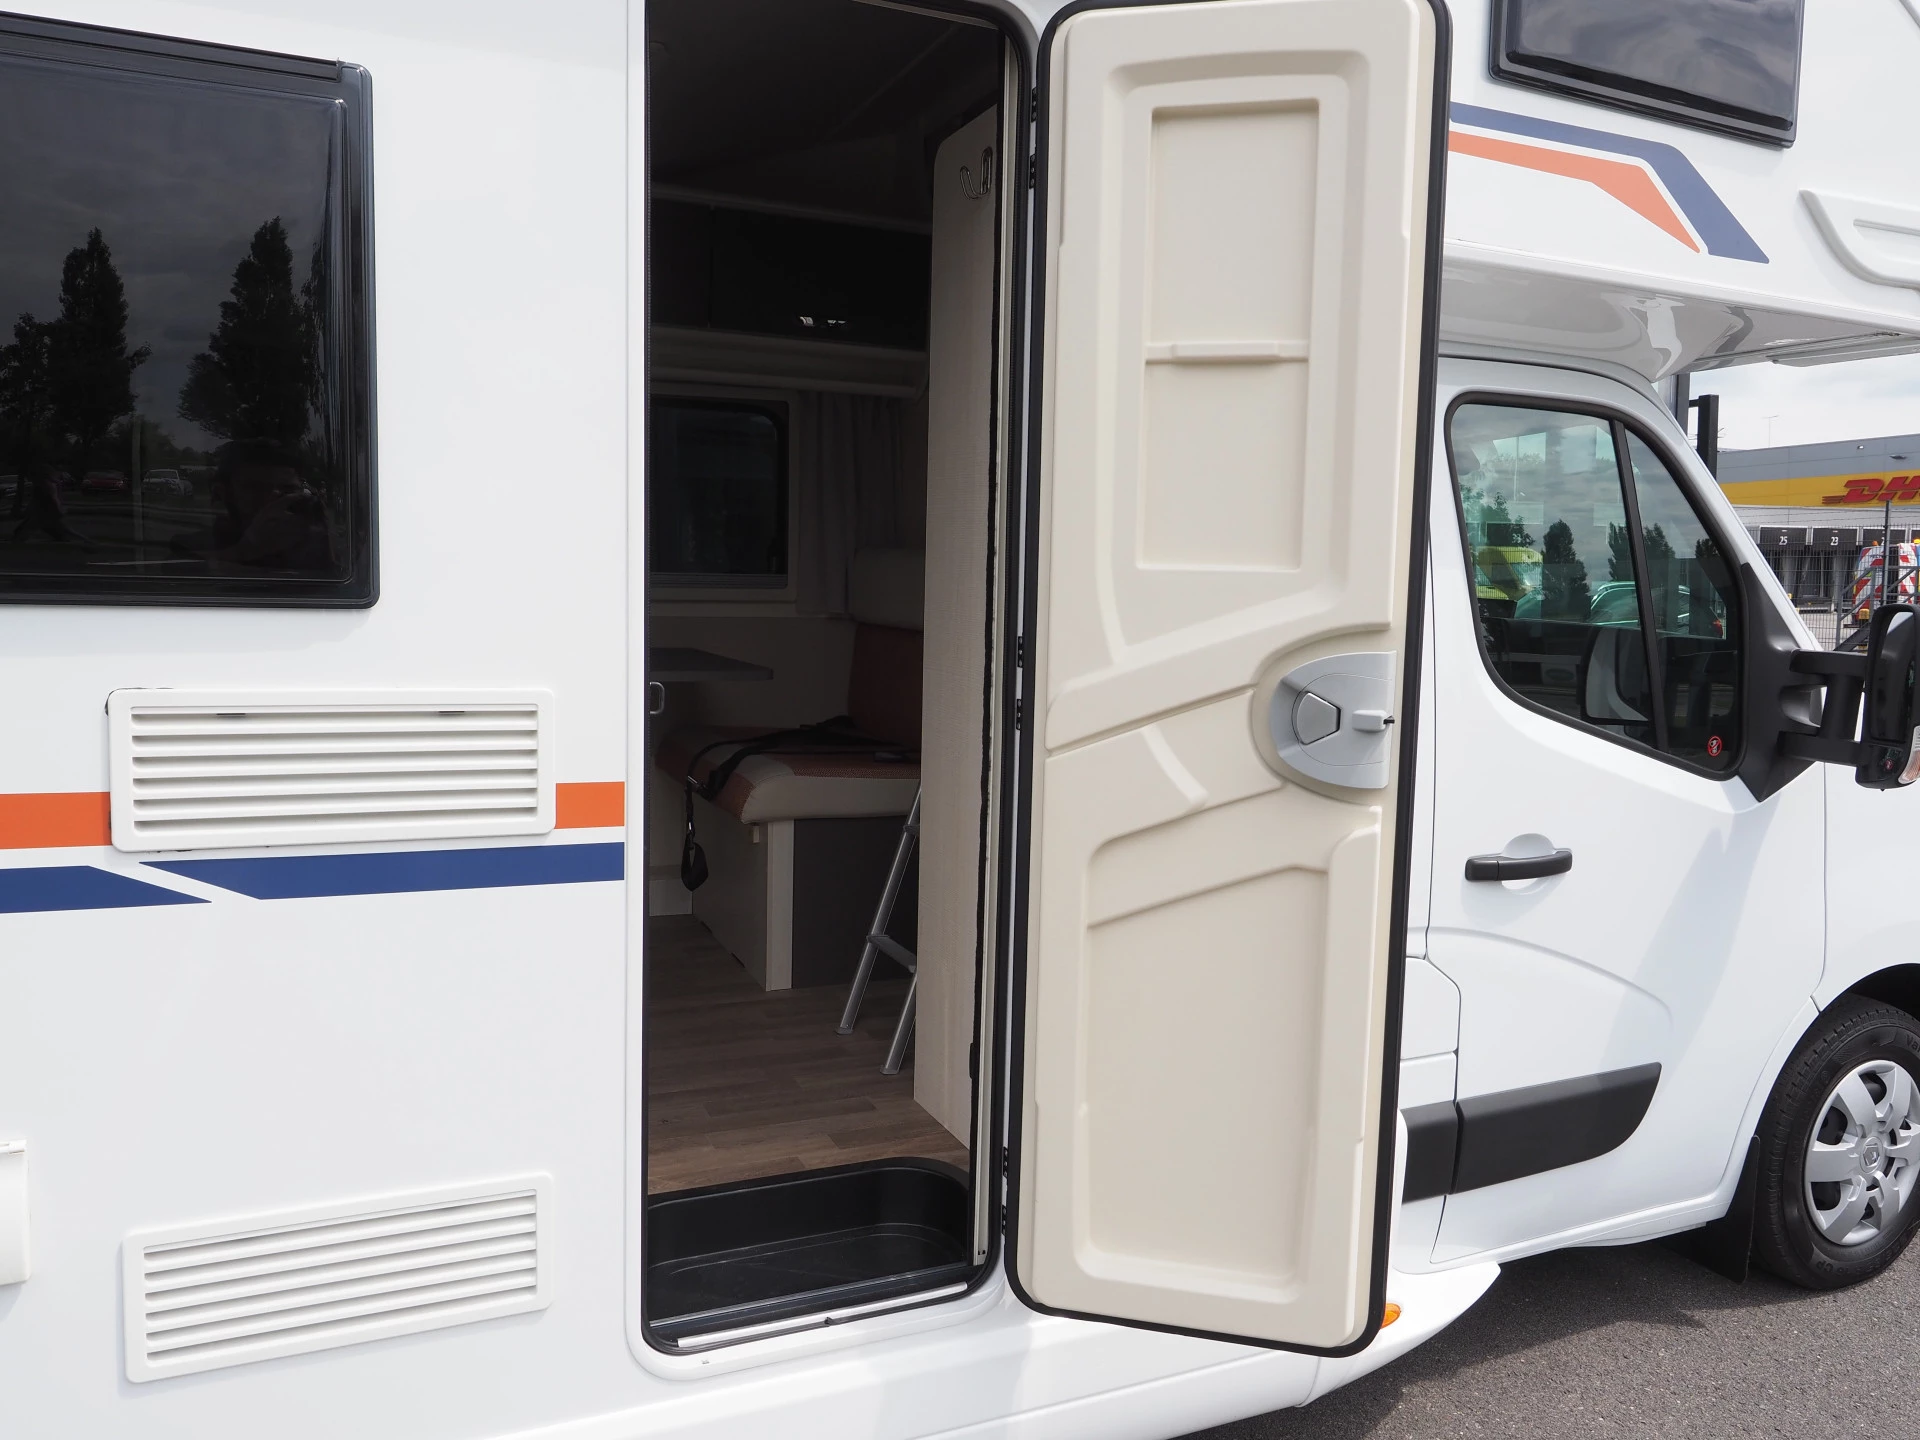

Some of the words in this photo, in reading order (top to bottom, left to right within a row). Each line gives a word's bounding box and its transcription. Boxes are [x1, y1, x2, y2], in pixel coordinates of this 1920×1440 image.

[1842, 475, 1920, 503] DH
[1779, 536, 1788, 546] 25
[1830, 536, 1839, 546] 23
